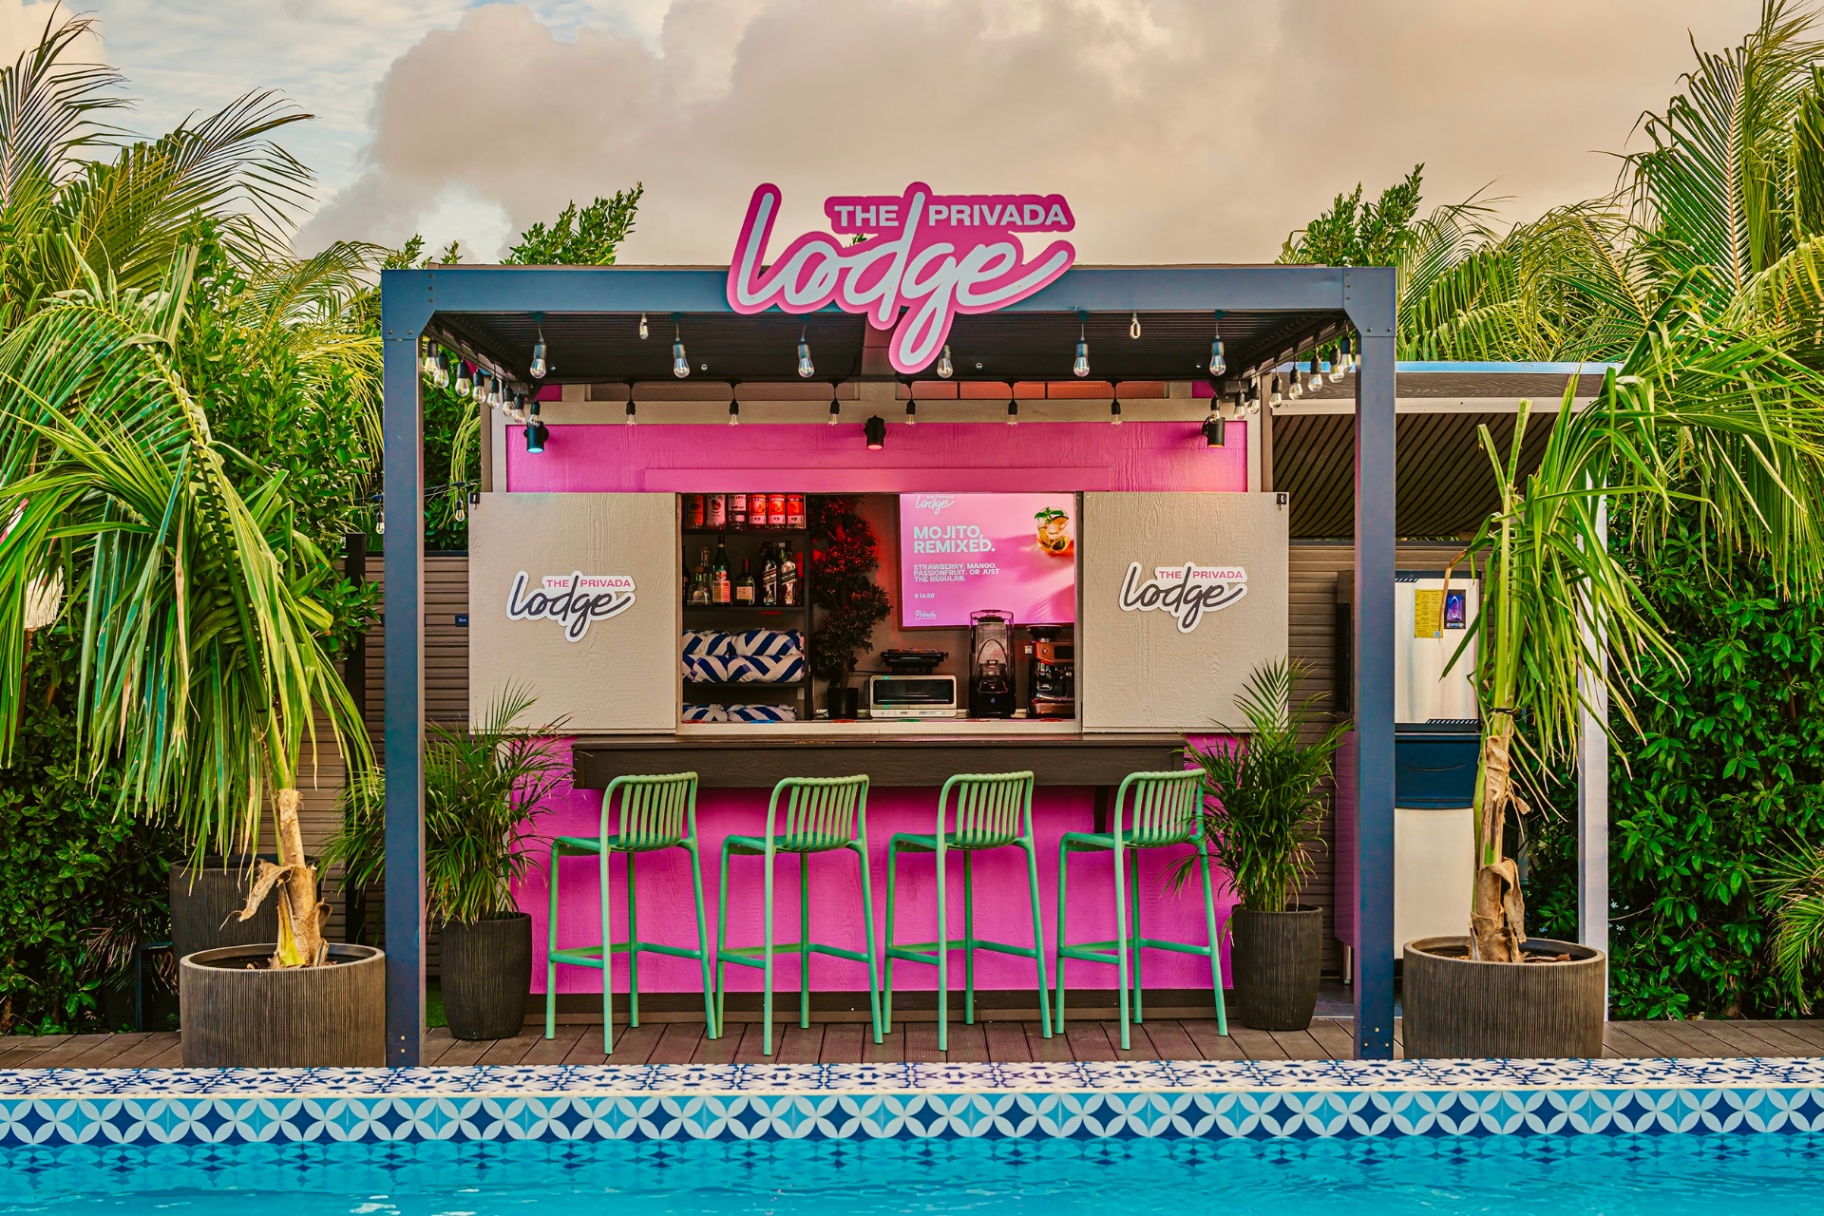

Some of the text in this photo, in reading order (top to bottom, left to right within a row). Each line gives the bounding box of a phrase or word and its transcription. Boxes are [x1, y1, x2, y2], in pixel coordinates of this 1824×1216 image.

[834, 204, 1068, 227] THE PRIVADA
[913, 525, 984, 541] MOJITO,
[914, 538, 996, 554] REMIXED.
[1159, 570, 1243, 579] THE PRIVADA
[546, 579, 631, 588] THE PRIVADA
